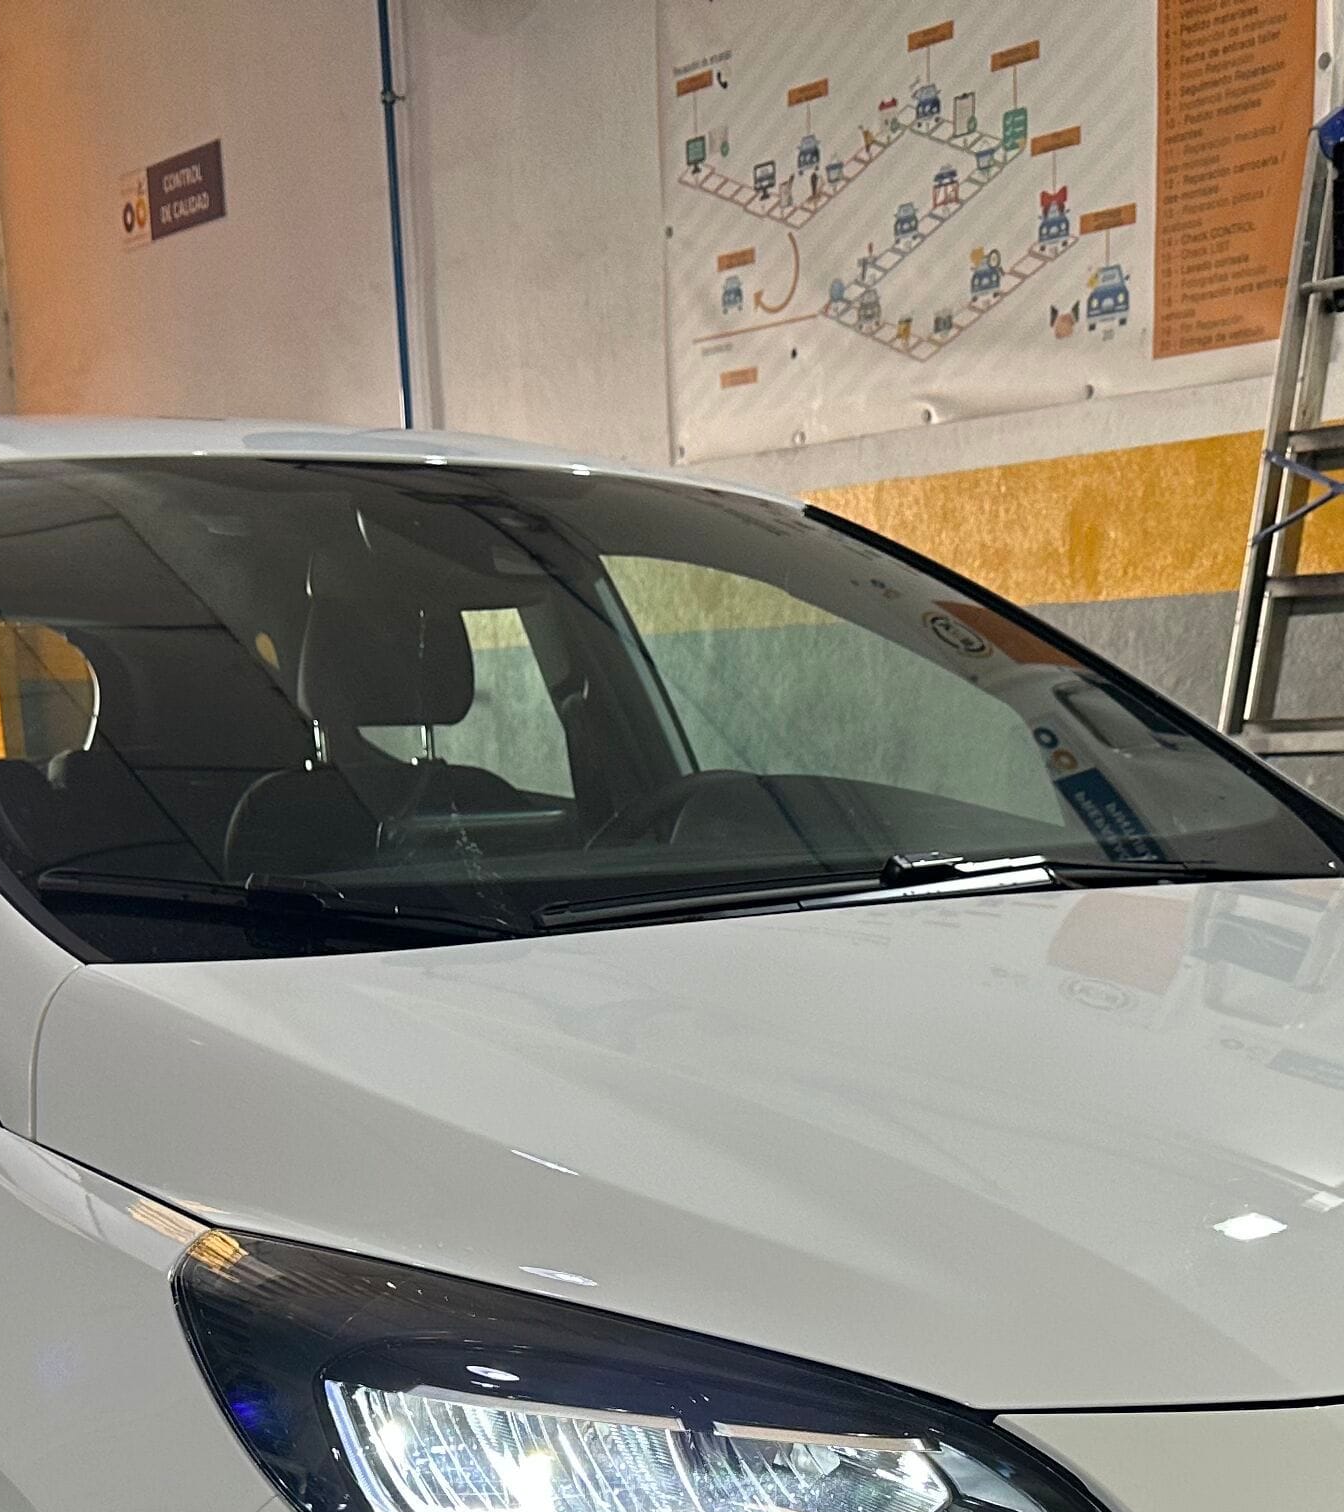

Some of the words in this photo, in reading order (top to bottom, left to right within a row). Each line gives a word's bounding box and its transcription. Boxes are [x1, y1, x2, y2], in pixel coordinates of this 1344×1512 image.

[1207, 48, 1220, 59] de
[163, 162, 202, 194] CONTROL
[160, 202, 173, 224] DE
[173, 191, 210, 218] CALIDAD
